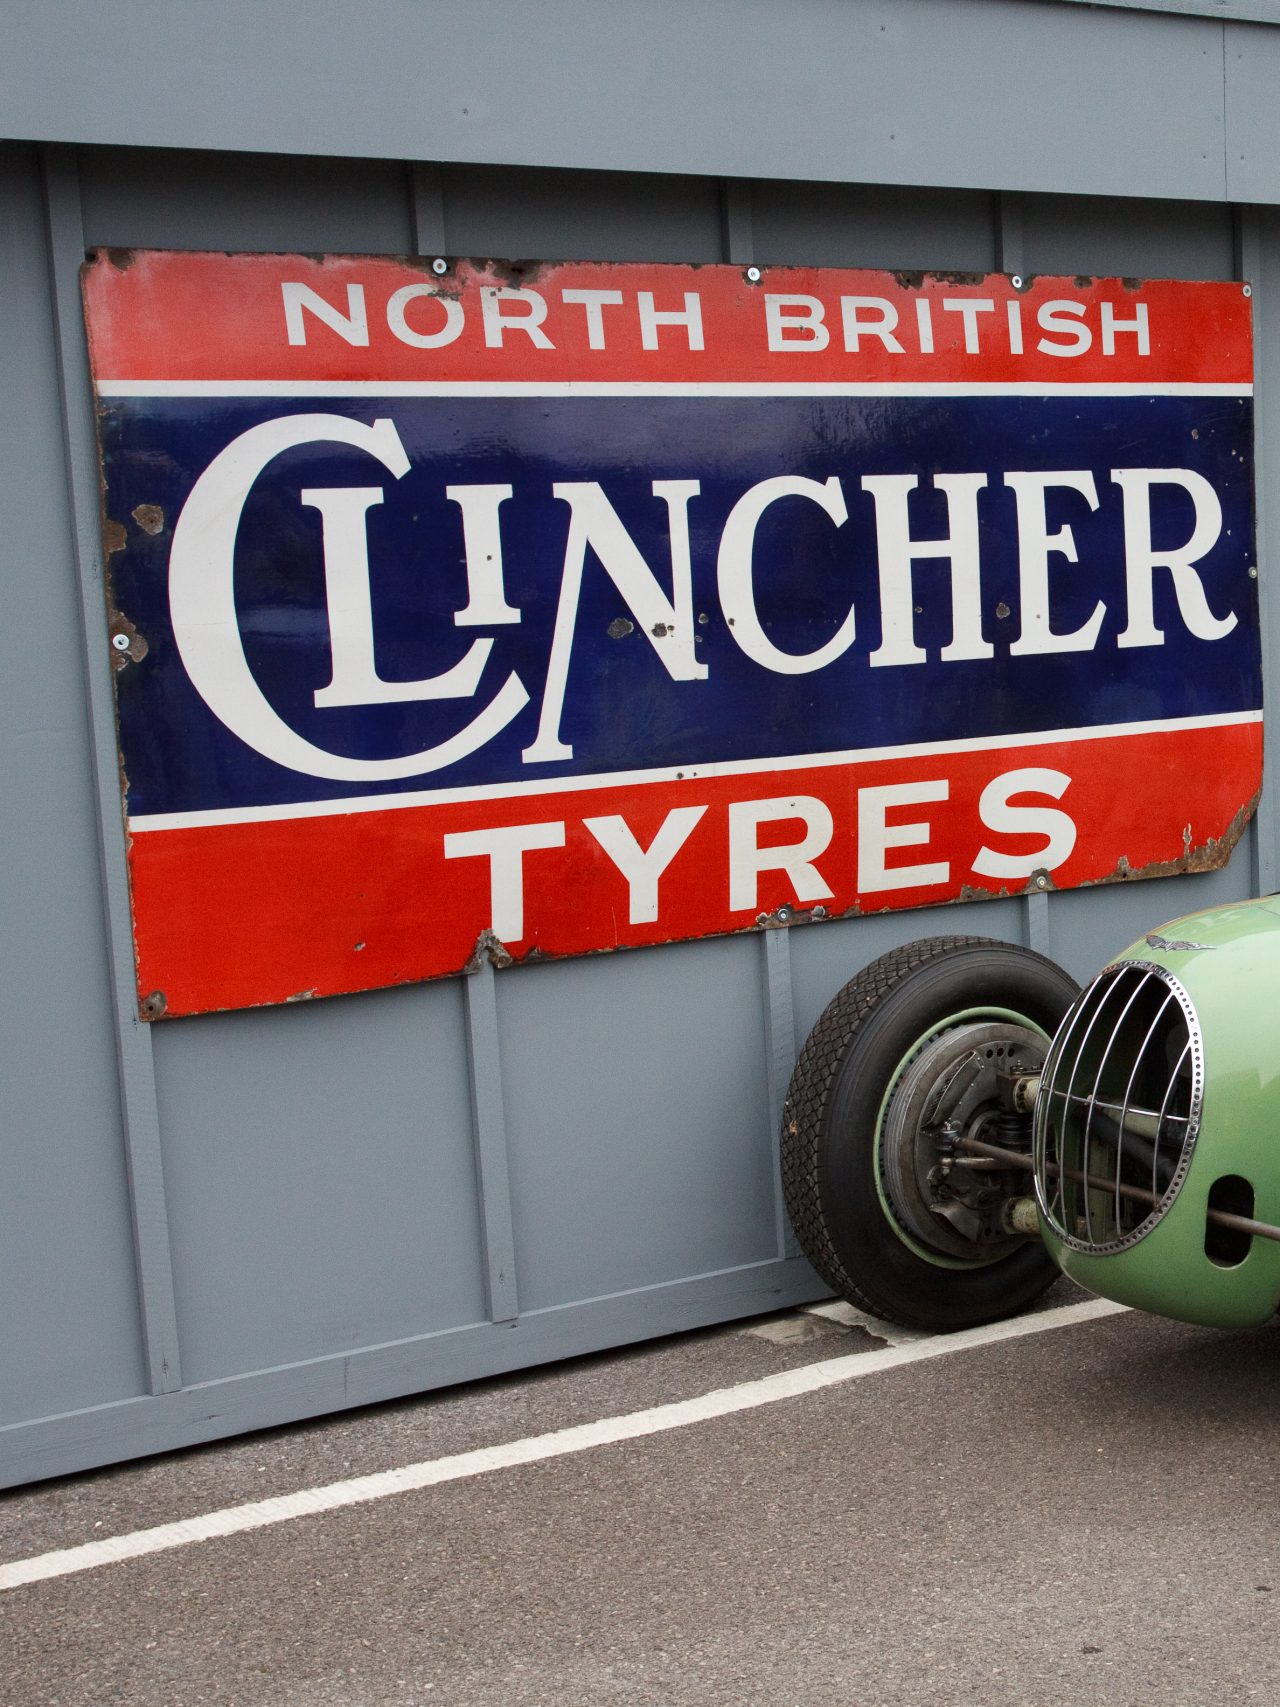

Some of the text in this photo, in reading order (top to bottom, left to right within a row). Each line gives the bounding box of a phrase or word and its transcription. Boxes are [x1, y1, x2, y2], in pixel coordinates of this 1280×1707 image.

[281, 281, 1151, 358] NORTH BRITISH
[167, 412, 1239, 782] CLINCHER
[443, 766, 1079, 944] TYRES
